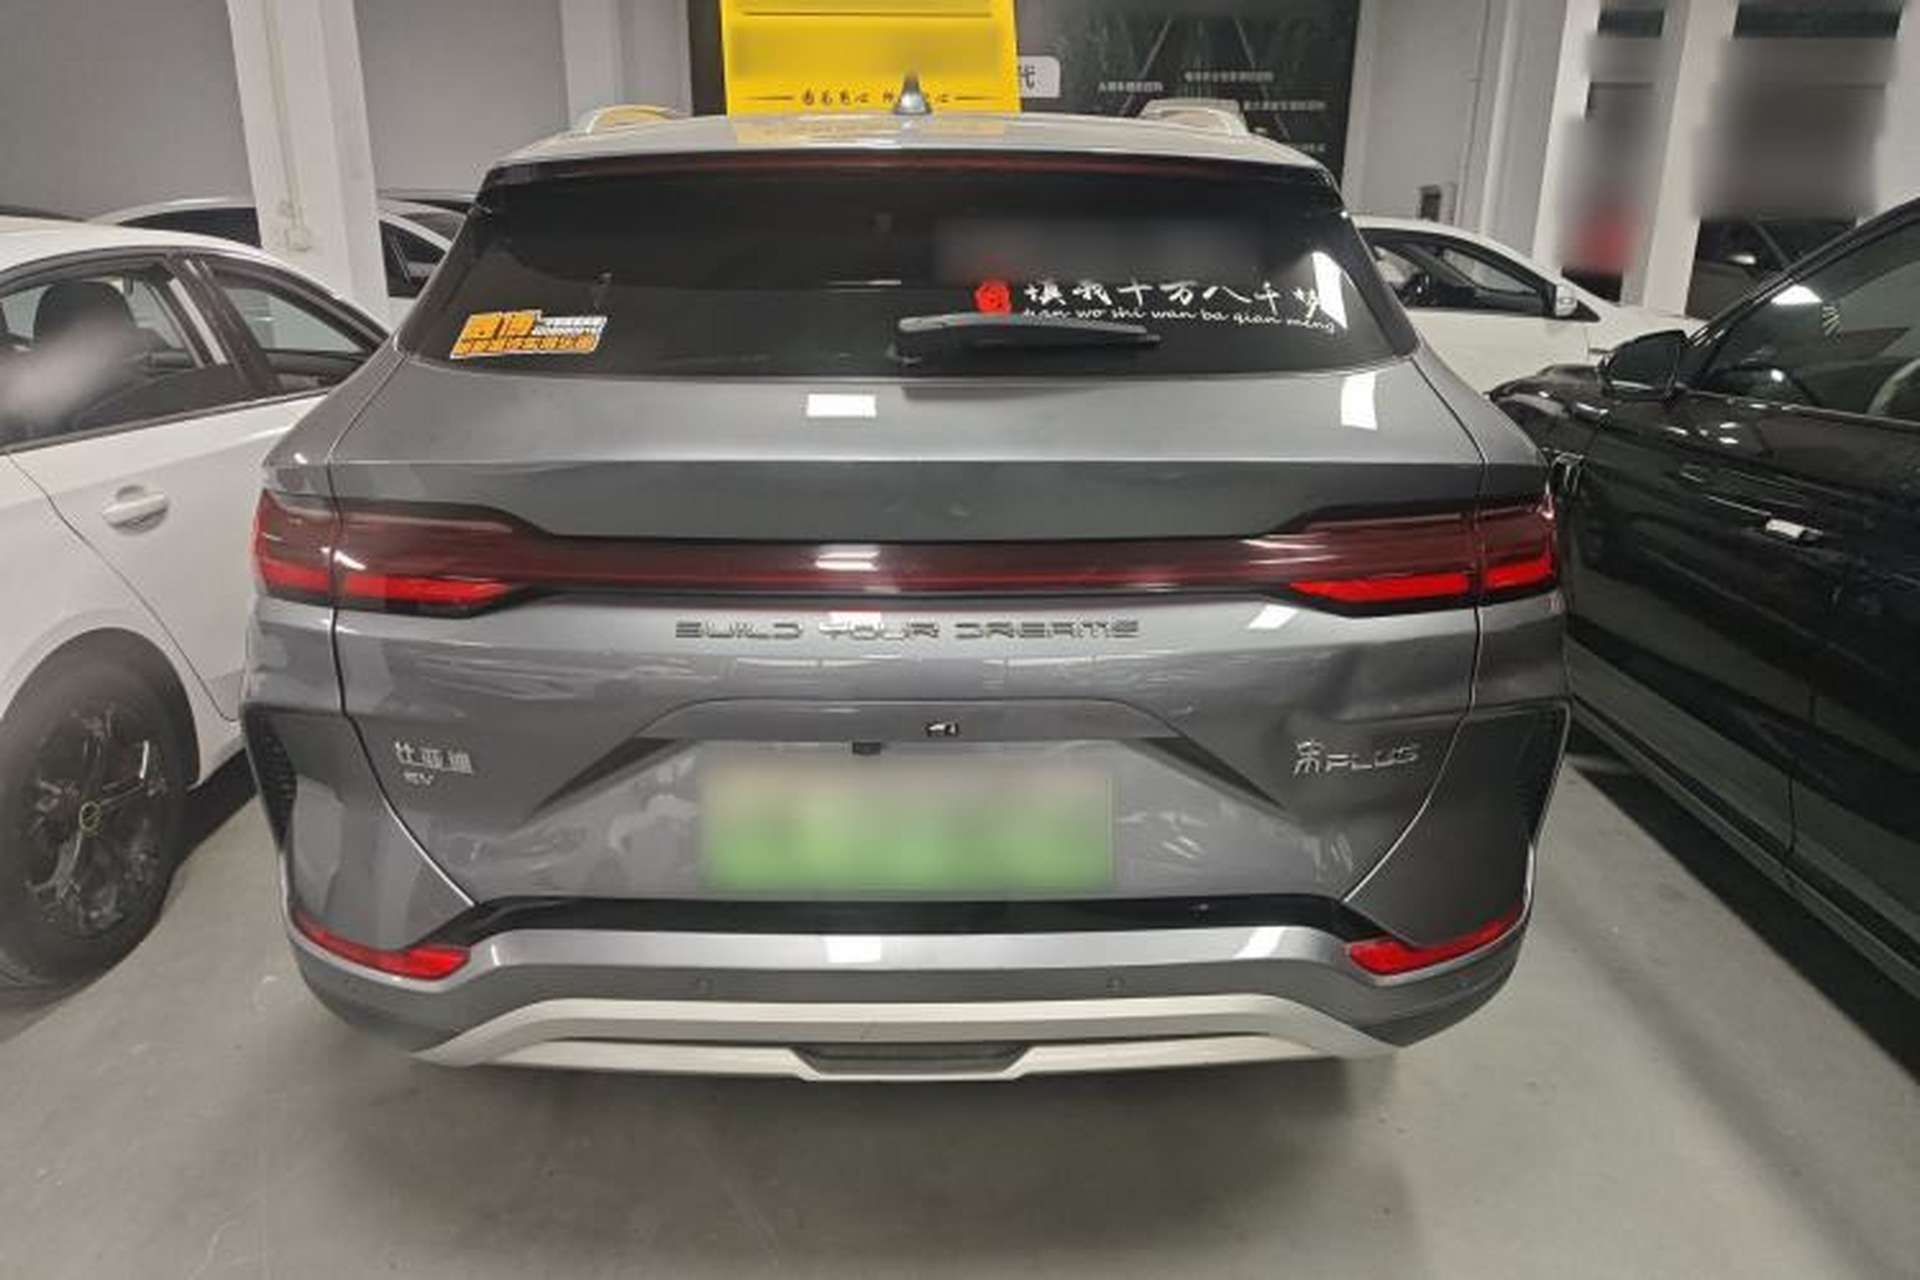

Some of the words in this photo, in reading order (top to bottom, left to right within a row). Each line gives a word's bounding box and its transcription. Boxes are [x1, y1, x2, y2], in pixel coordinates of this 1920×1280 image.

[1074, 307, 1106, 319] wo
[1150, 310, 1199, 319] wan
[1200, 308, 1229, 321] ba
[1233, 312, 1281, 327] qian
[675, 621, 803, 639] BUILD
[818, 621, 940, 641] YOUR
[954, 619, 1140, 640] DREAMS
